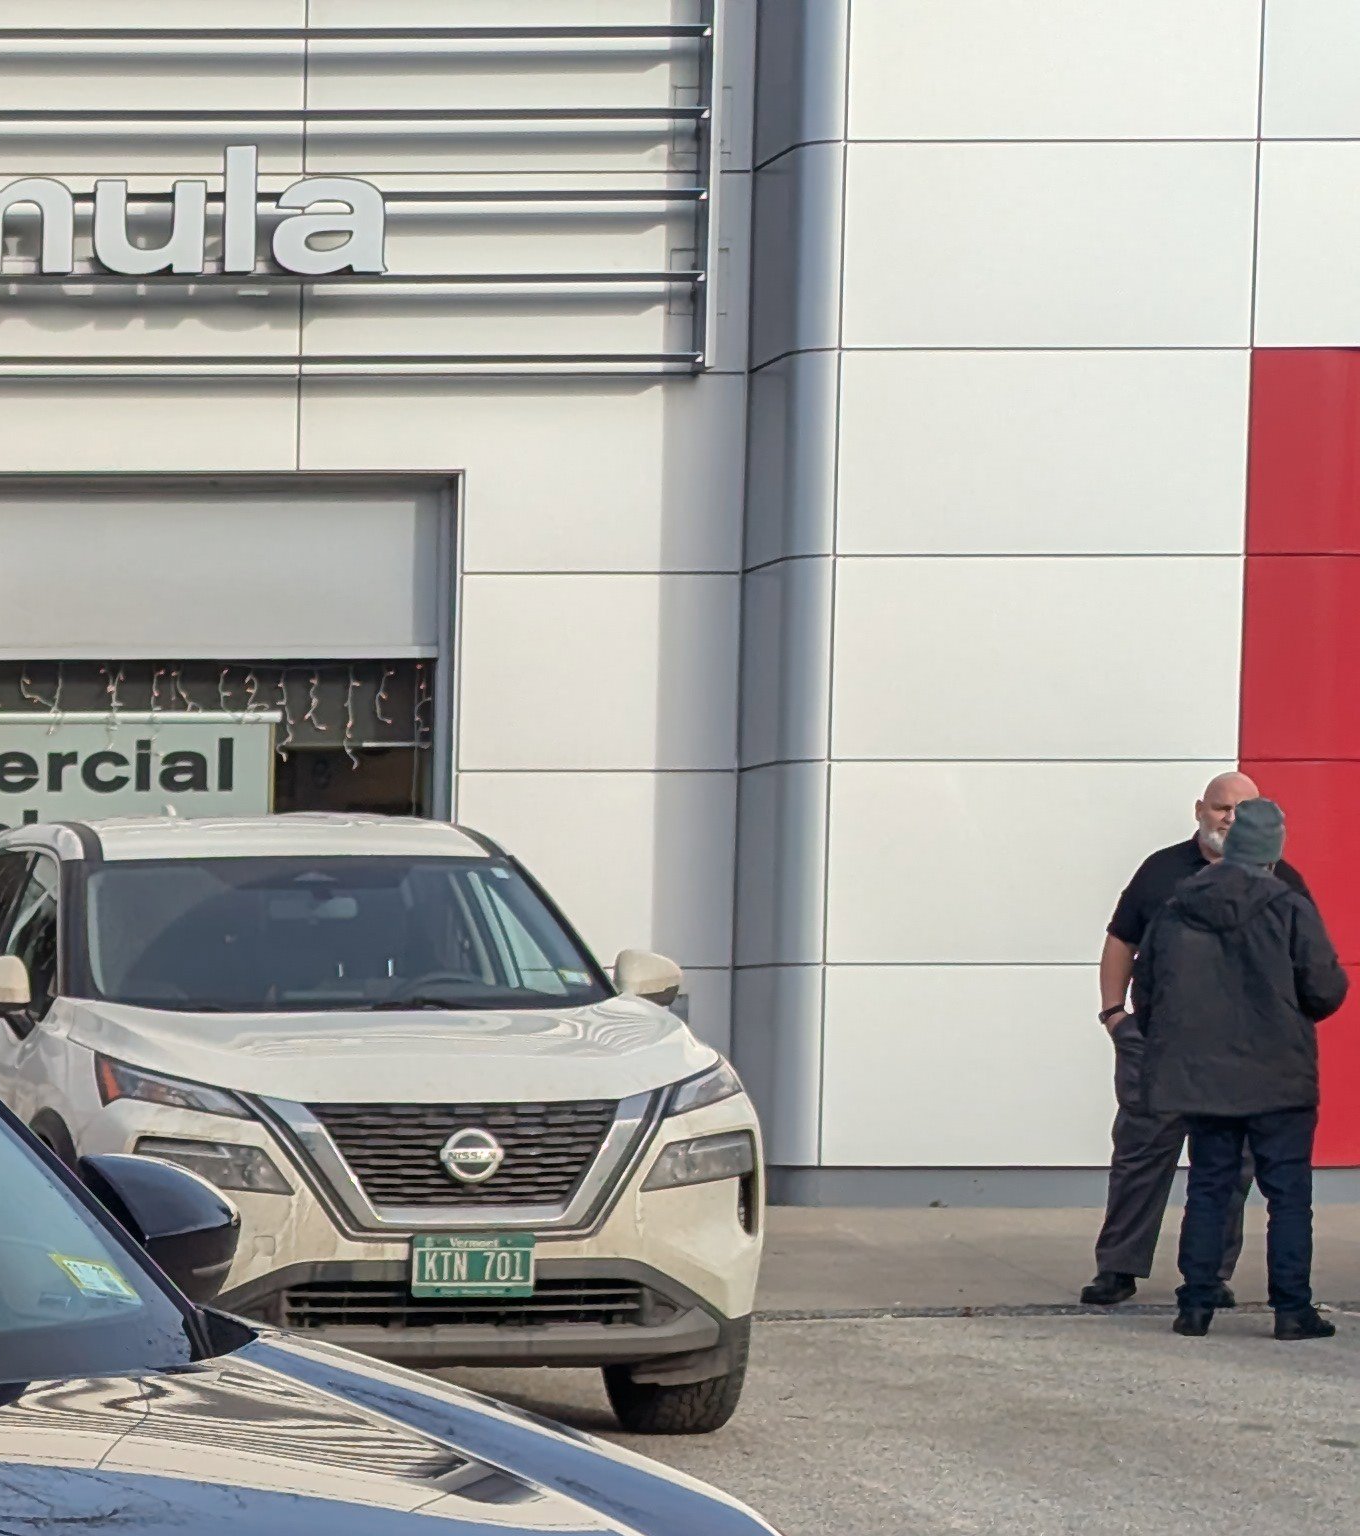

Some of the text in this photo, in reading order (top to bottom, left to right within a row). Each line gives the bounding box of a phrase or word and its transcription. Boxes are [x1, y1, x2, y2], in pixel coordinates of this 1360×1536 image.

[449, 1237, 499, 1248] Vermont
[424, 1251, 524, 1281] KTN 701
